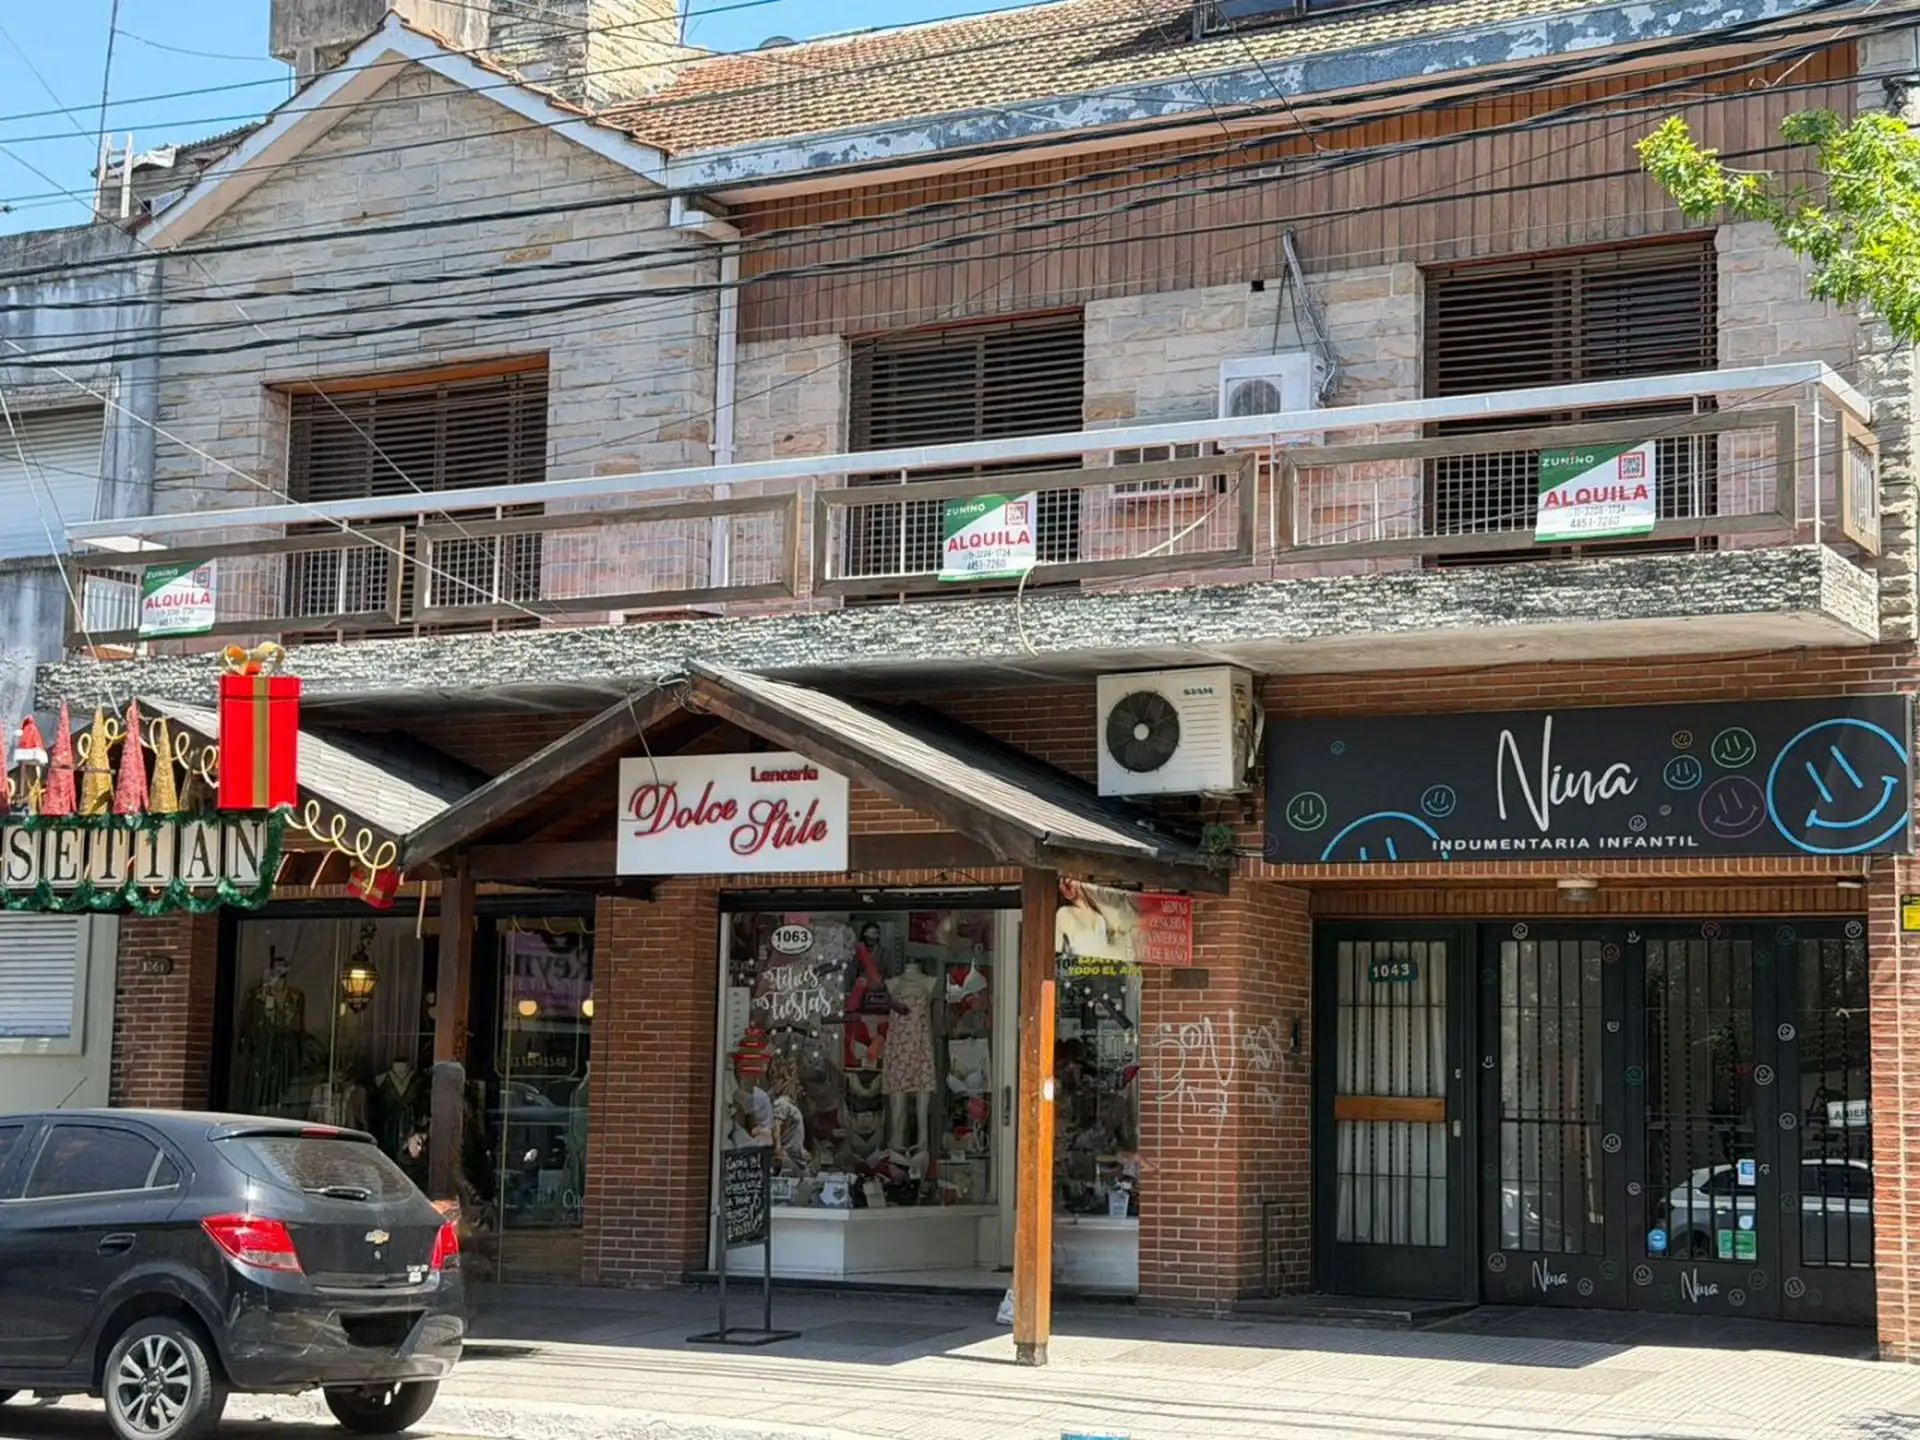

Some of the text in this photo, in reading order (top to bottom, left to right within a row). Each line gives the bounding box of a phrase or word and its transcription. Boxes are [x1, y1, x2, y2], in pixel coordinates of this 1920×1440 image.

[1542, 454, 1595, 468] ZUNINO
[1544, 483, 1649, 509] ALQUILA
[946, 503, 986, 517] ZUNINO
[948, 530, 1030, 553] ALQUILA
[145, 592, 211, 611] ALQUILA
[1496, 714, 1639, 832] Nina
[628, 780, 828, 855] Dolce Stile
[1431, 835, 1699, 851] INDUMENTARIA INFANTIL
[776, 930, 809, 943] 1063
[1068, 964, 1100, 977] TODO
[1373, 963, 1410, 978] 1043
[1532, 1257, 1569, 1292] Nina
[1680, 1268, 1719, 1304] Nina
